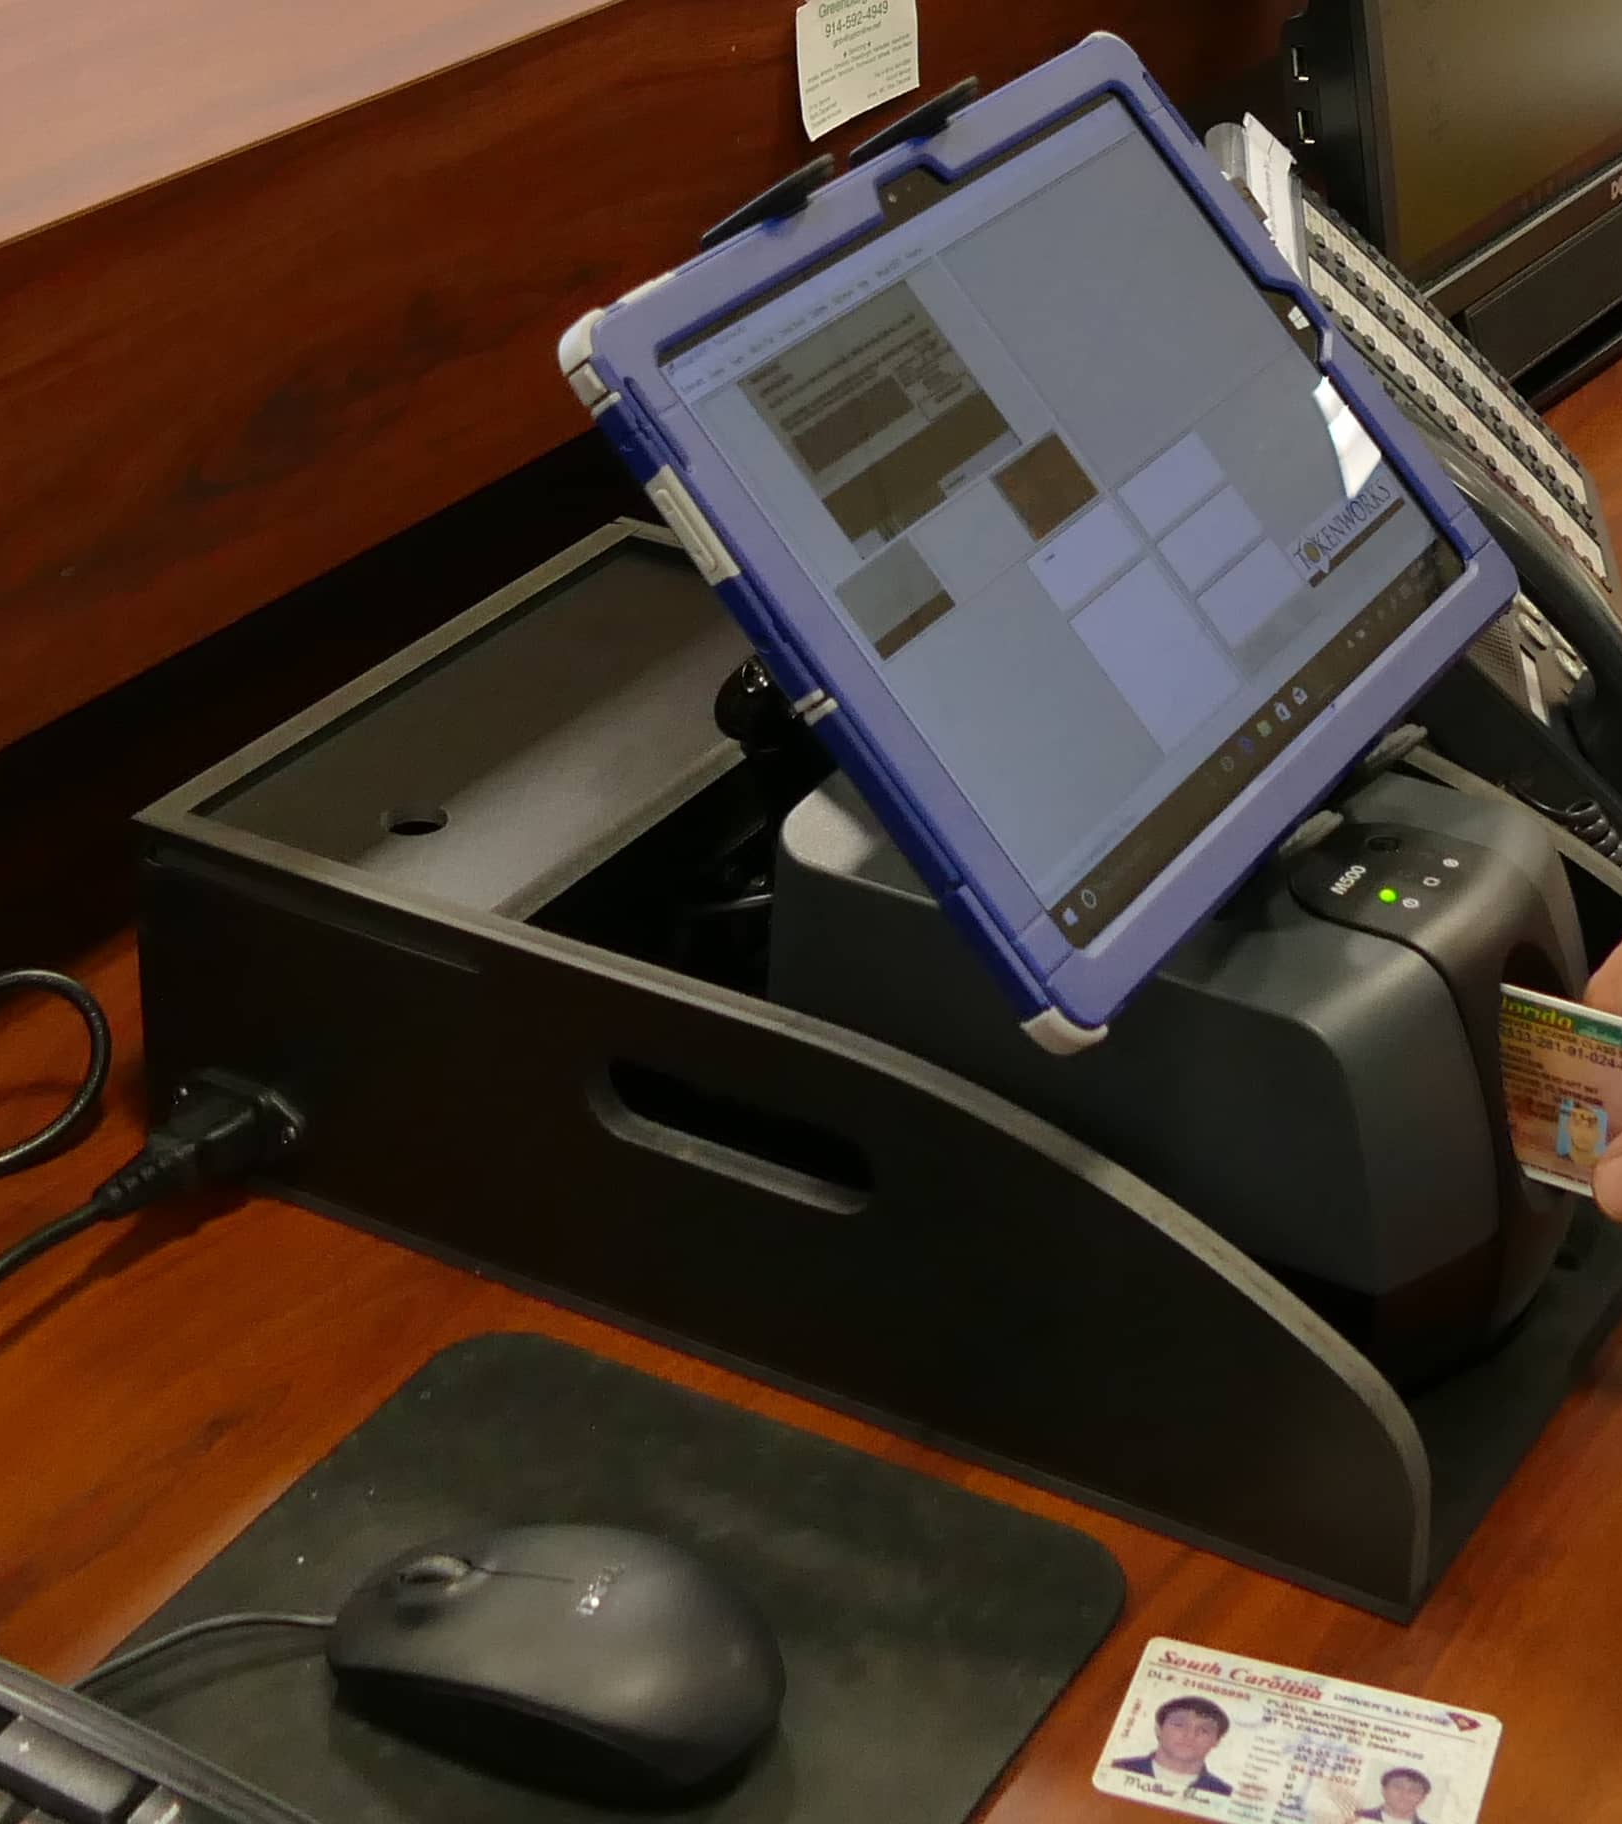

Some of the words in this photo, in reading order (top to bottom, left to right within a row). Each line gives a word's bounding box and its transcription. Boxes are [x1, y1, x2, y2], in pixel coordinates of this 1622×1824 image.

[1293, 478, 1392, 570] TOKENWORKS
[1329, 864, 1367, 896] M500
[1158, 1648, 1222, 1676] South
[1228, 1666, 1323, 1701] Carolina
